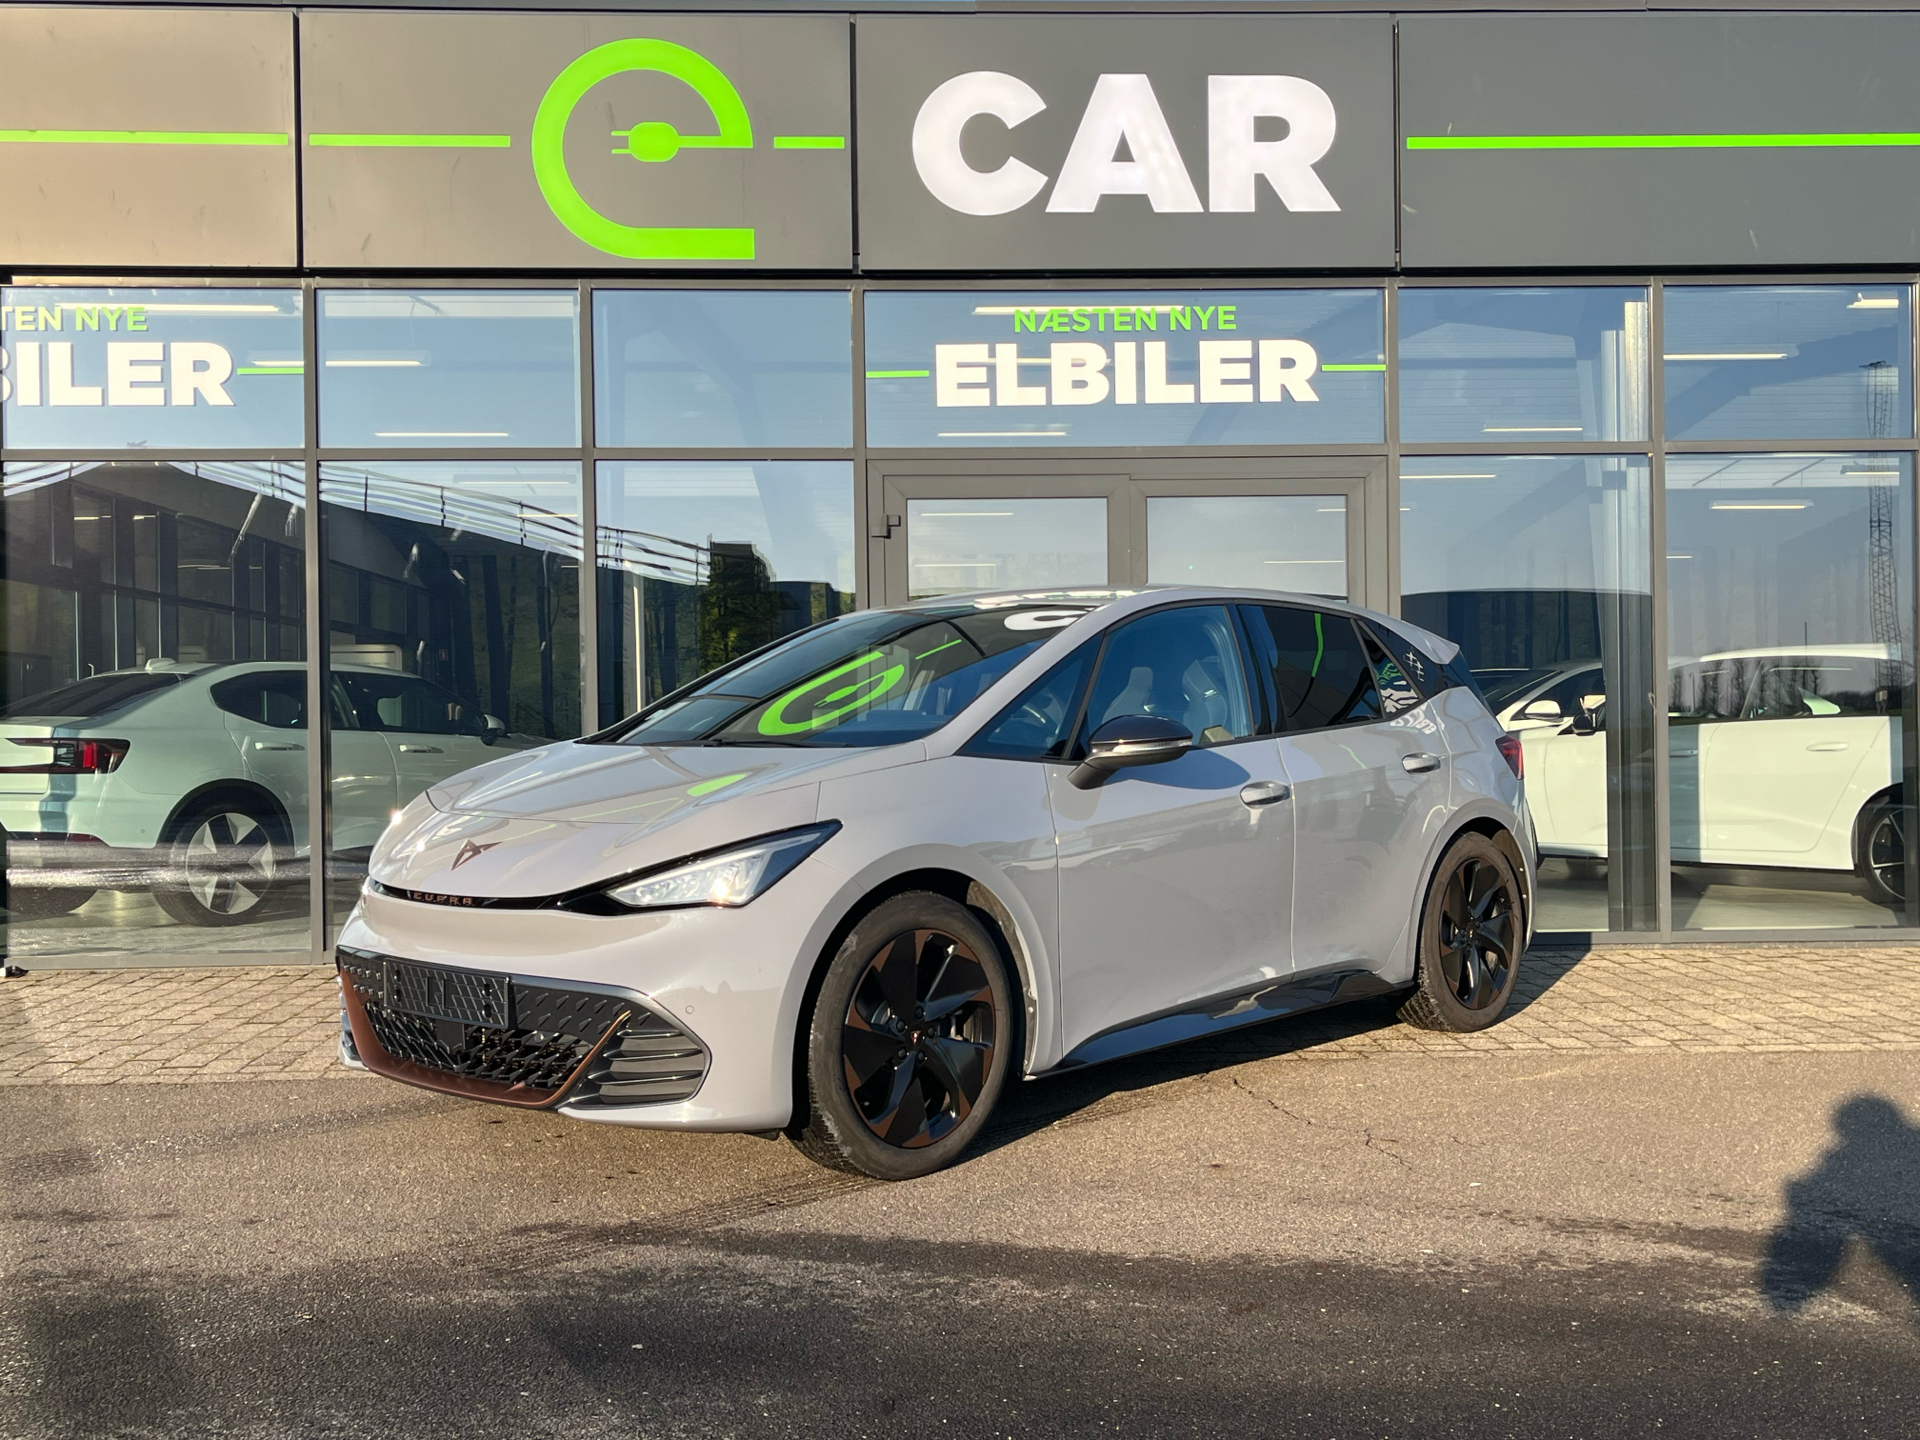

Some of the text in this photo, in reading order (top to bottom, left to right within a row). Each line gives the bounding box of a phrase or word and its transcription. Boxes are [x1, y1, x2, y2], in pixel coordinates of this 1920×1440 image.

[911, 70, 1342, 217] CAR
[75, 306, 148, 332] NYE
[1013, 305, 1237, 333] NÆSTEN NYE
[0, 341, 235, 406] ILER
[935, 339, 1320, 407] ELBILER
[413, 892, 473, 906] CUPRA
